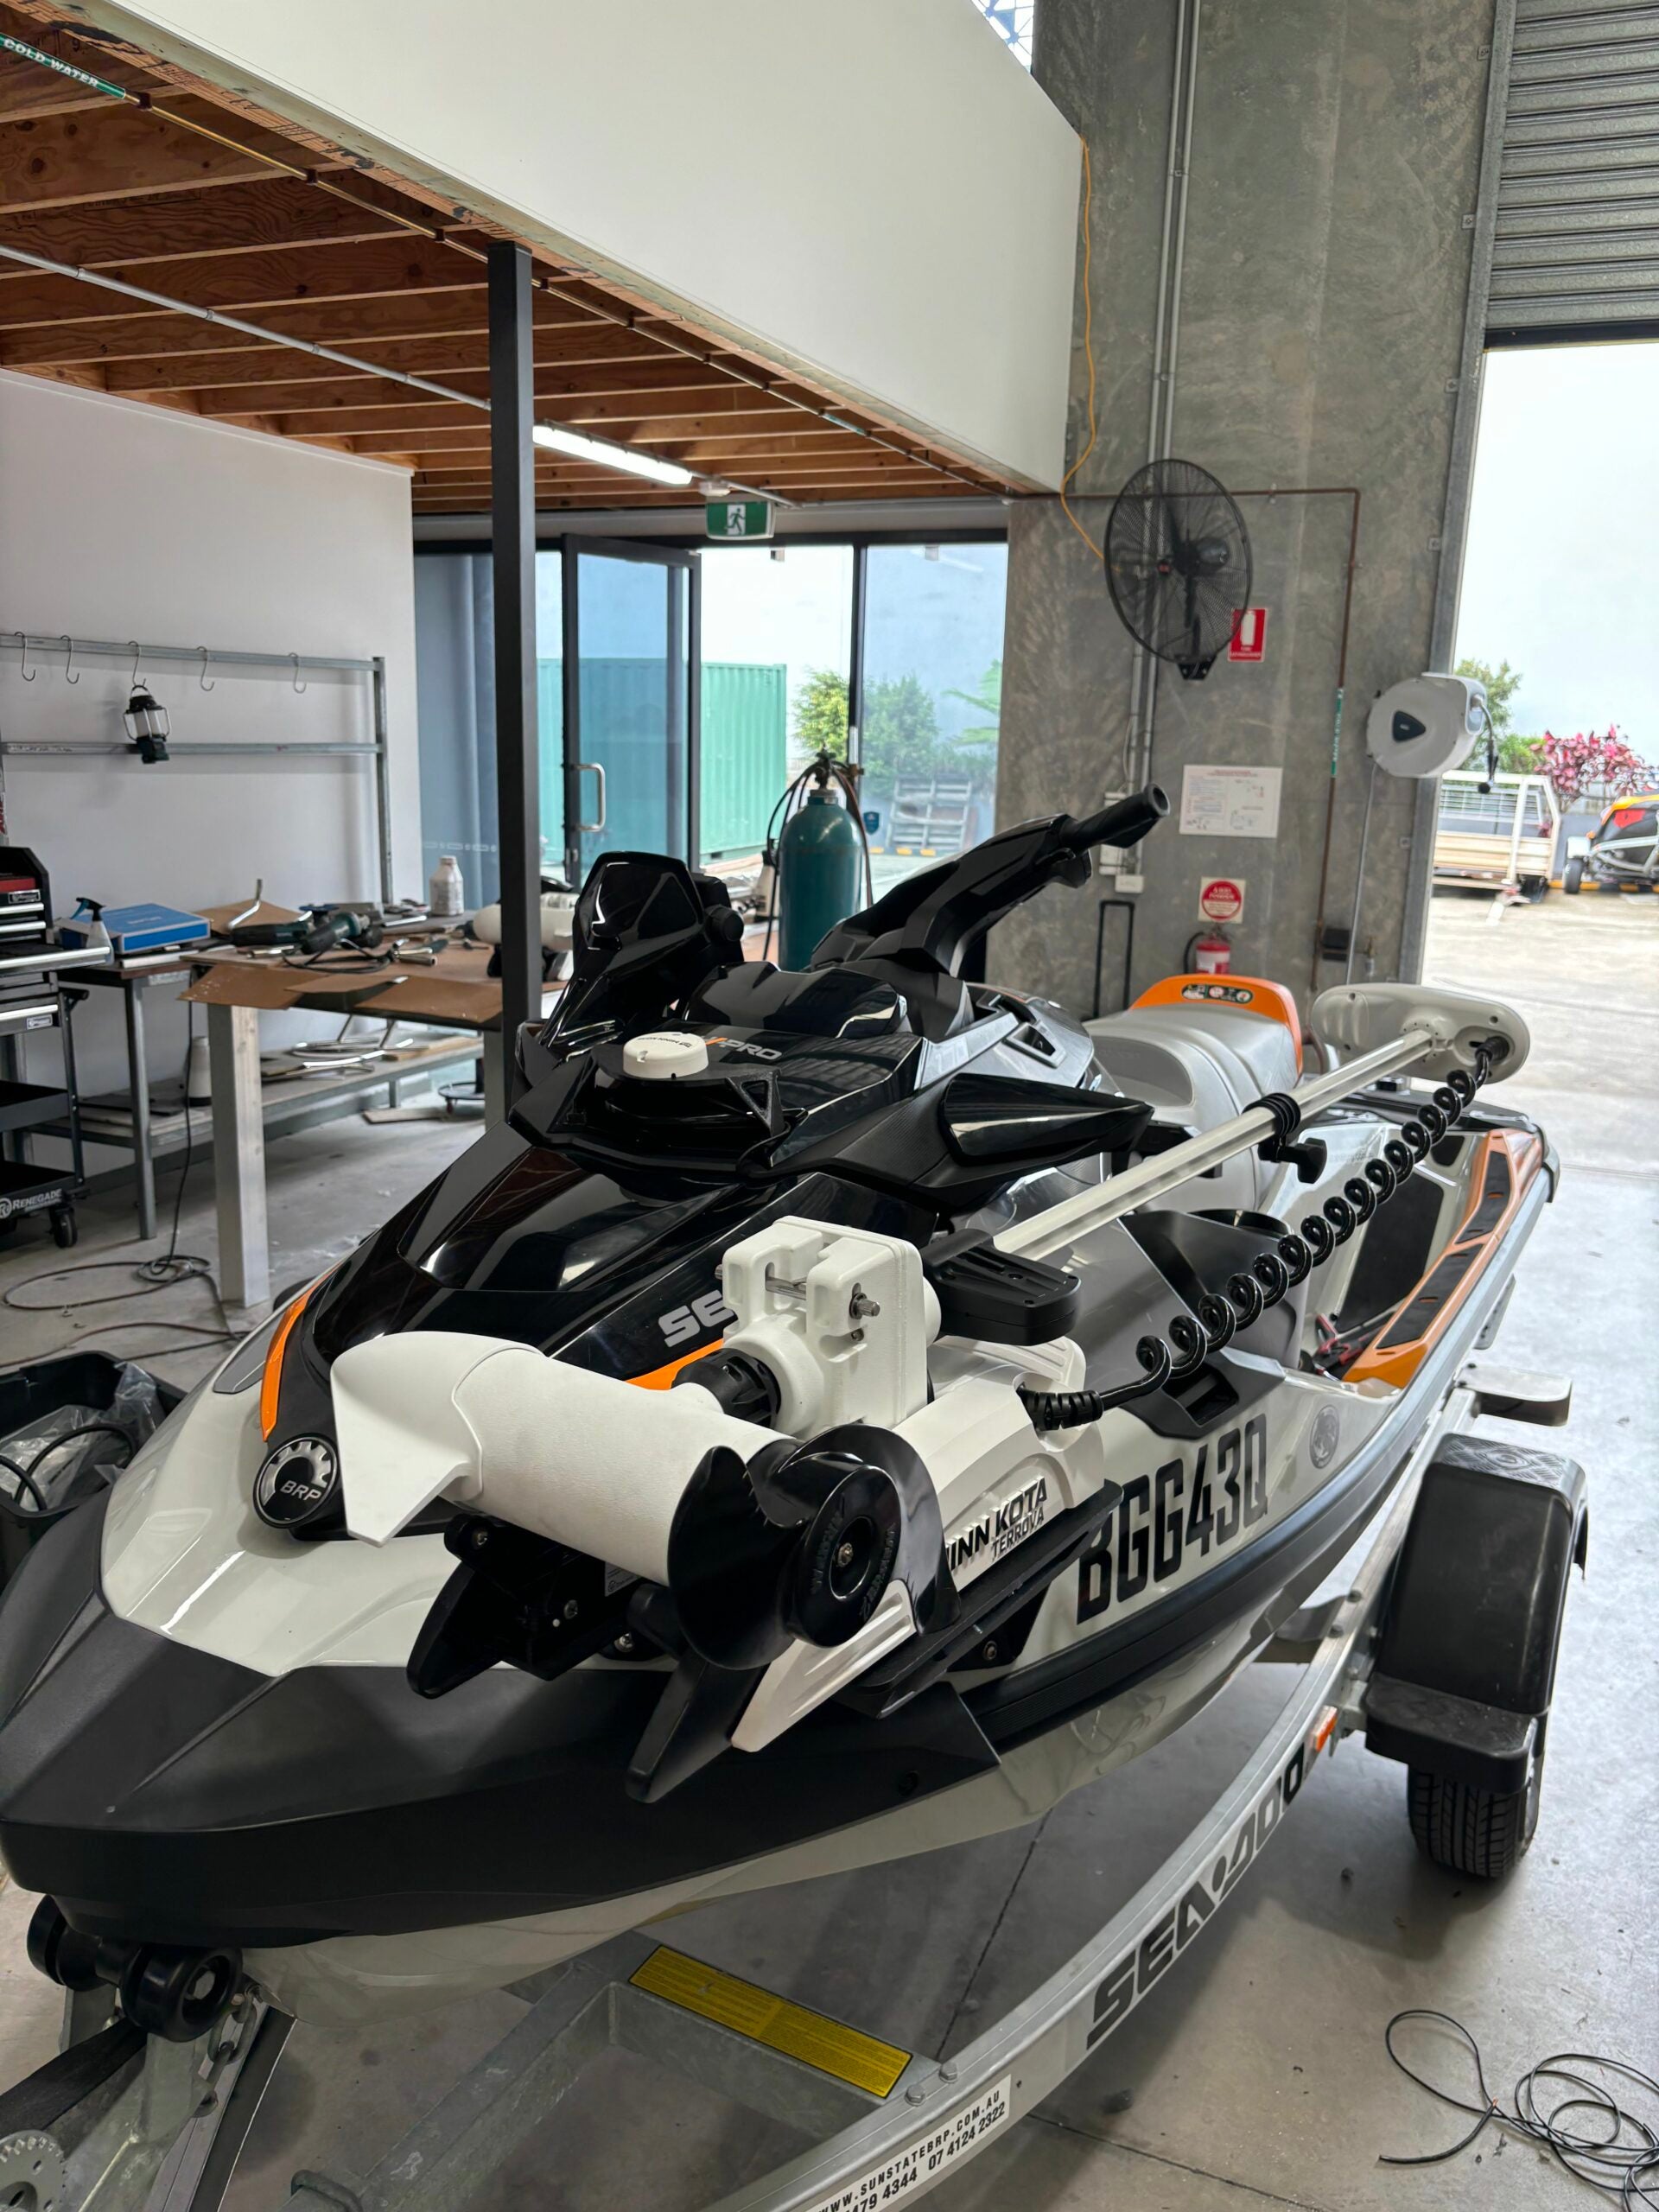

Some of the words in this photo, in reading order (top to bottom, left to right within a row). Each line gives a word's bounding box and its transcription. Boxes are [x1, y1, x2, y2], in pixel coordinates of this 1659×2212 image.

[3, 38, 46, 63] COLD
[50, 57, 99, 86] WATER
[12, 1188, 62, 1210] RENEGADE
[658, 1289, 735, 1348] SE
[280, 1480, 323, 1502] BRP
[945, 1516, 991, 1572] INN
[995, 1477, 1048, 1538] KOTA
[992, 1506, 1045, 1560] TERROVA
[882, 2166, 918, 2200] 4344
[928, 2148, 944, 2171] 07
[947, 2125, 976, 2157] 4124
[978, 2101, 1006, 2135] 2322
